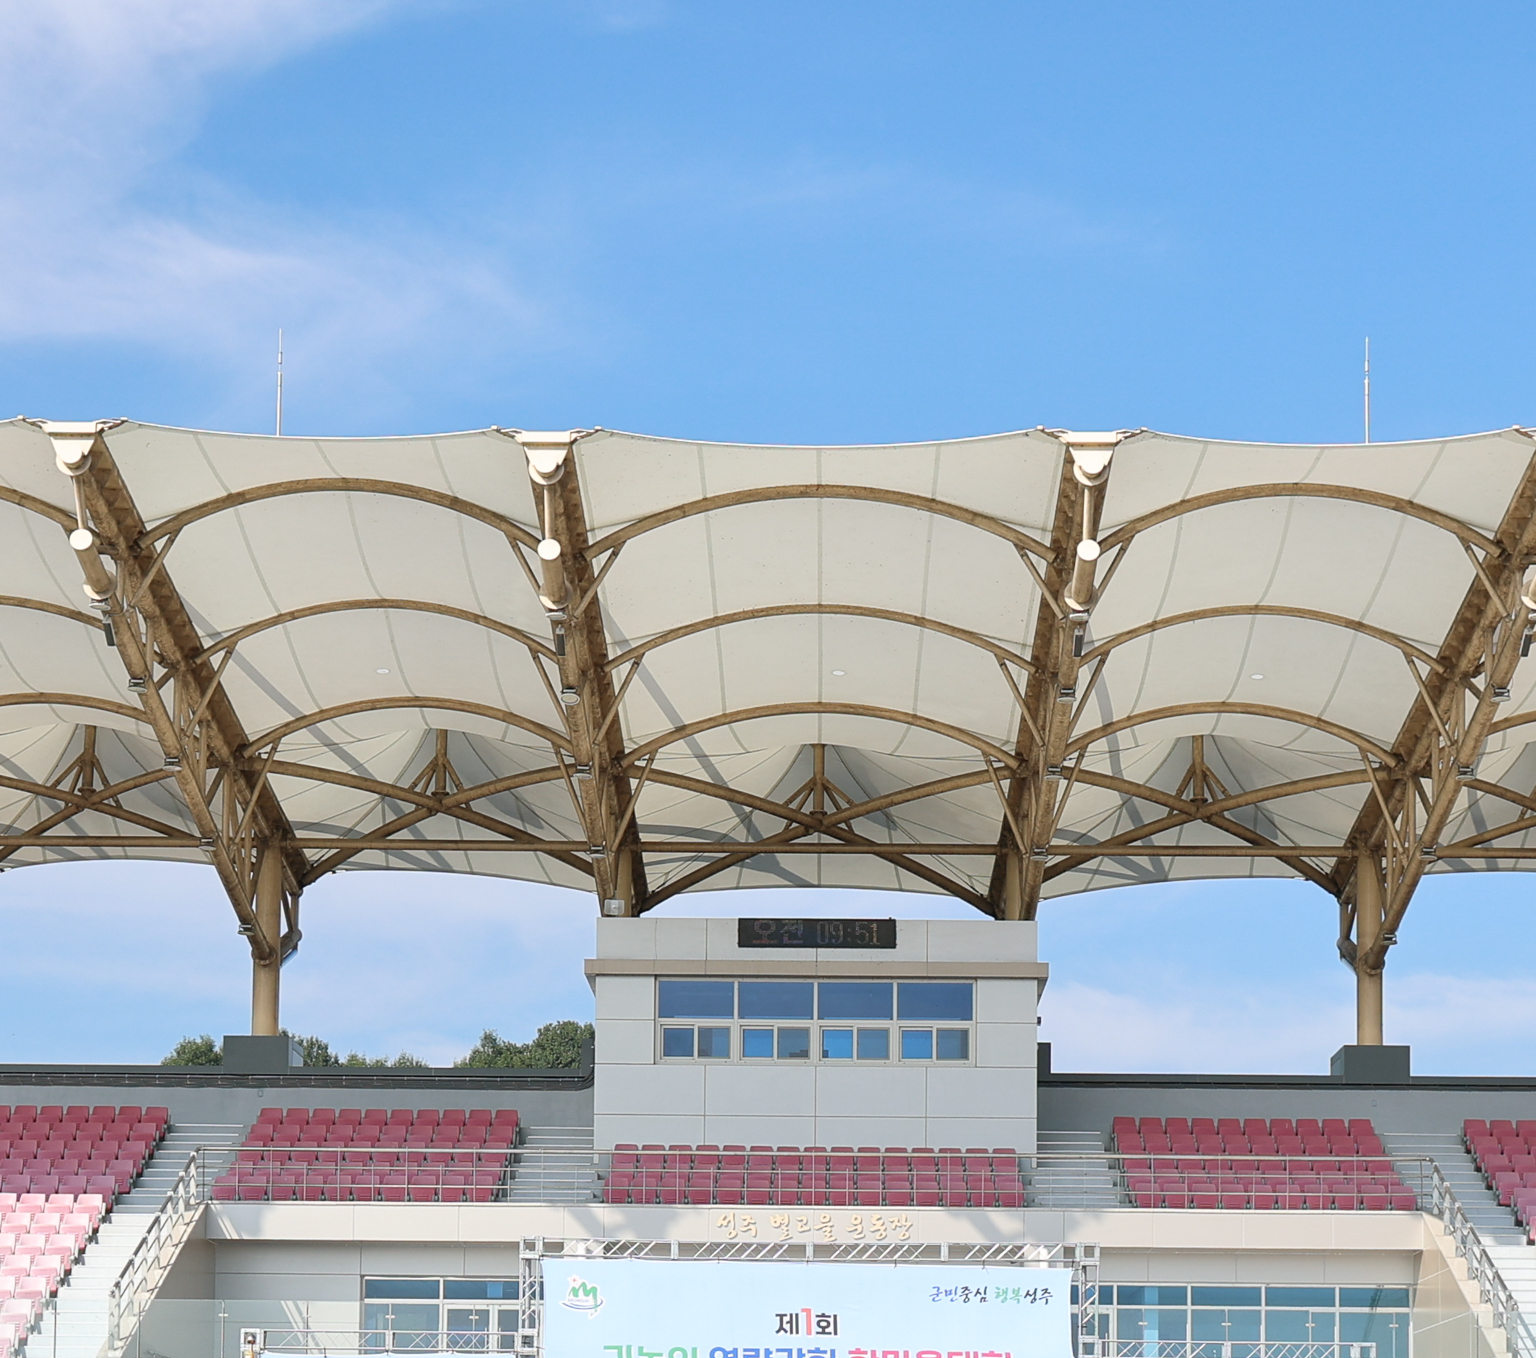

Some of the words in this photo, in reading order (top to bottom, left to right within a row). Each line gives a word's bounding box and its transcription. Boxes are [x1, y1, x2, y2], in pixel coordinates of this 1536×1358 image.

[752, 920, 804, 944] 오전
[816, 921, 880, 945] 09:51
[714, 1212, 759, 1240] 성주
[768, 1213, 836, 1242] 별고을
[845, 1213, 914, 1241] 운동장
[929, 1286, 989, 1303] 군민중심
[994, 1286, 1053, 1305] 행복성주
[774, 1307, 840, 1338] 제1회
